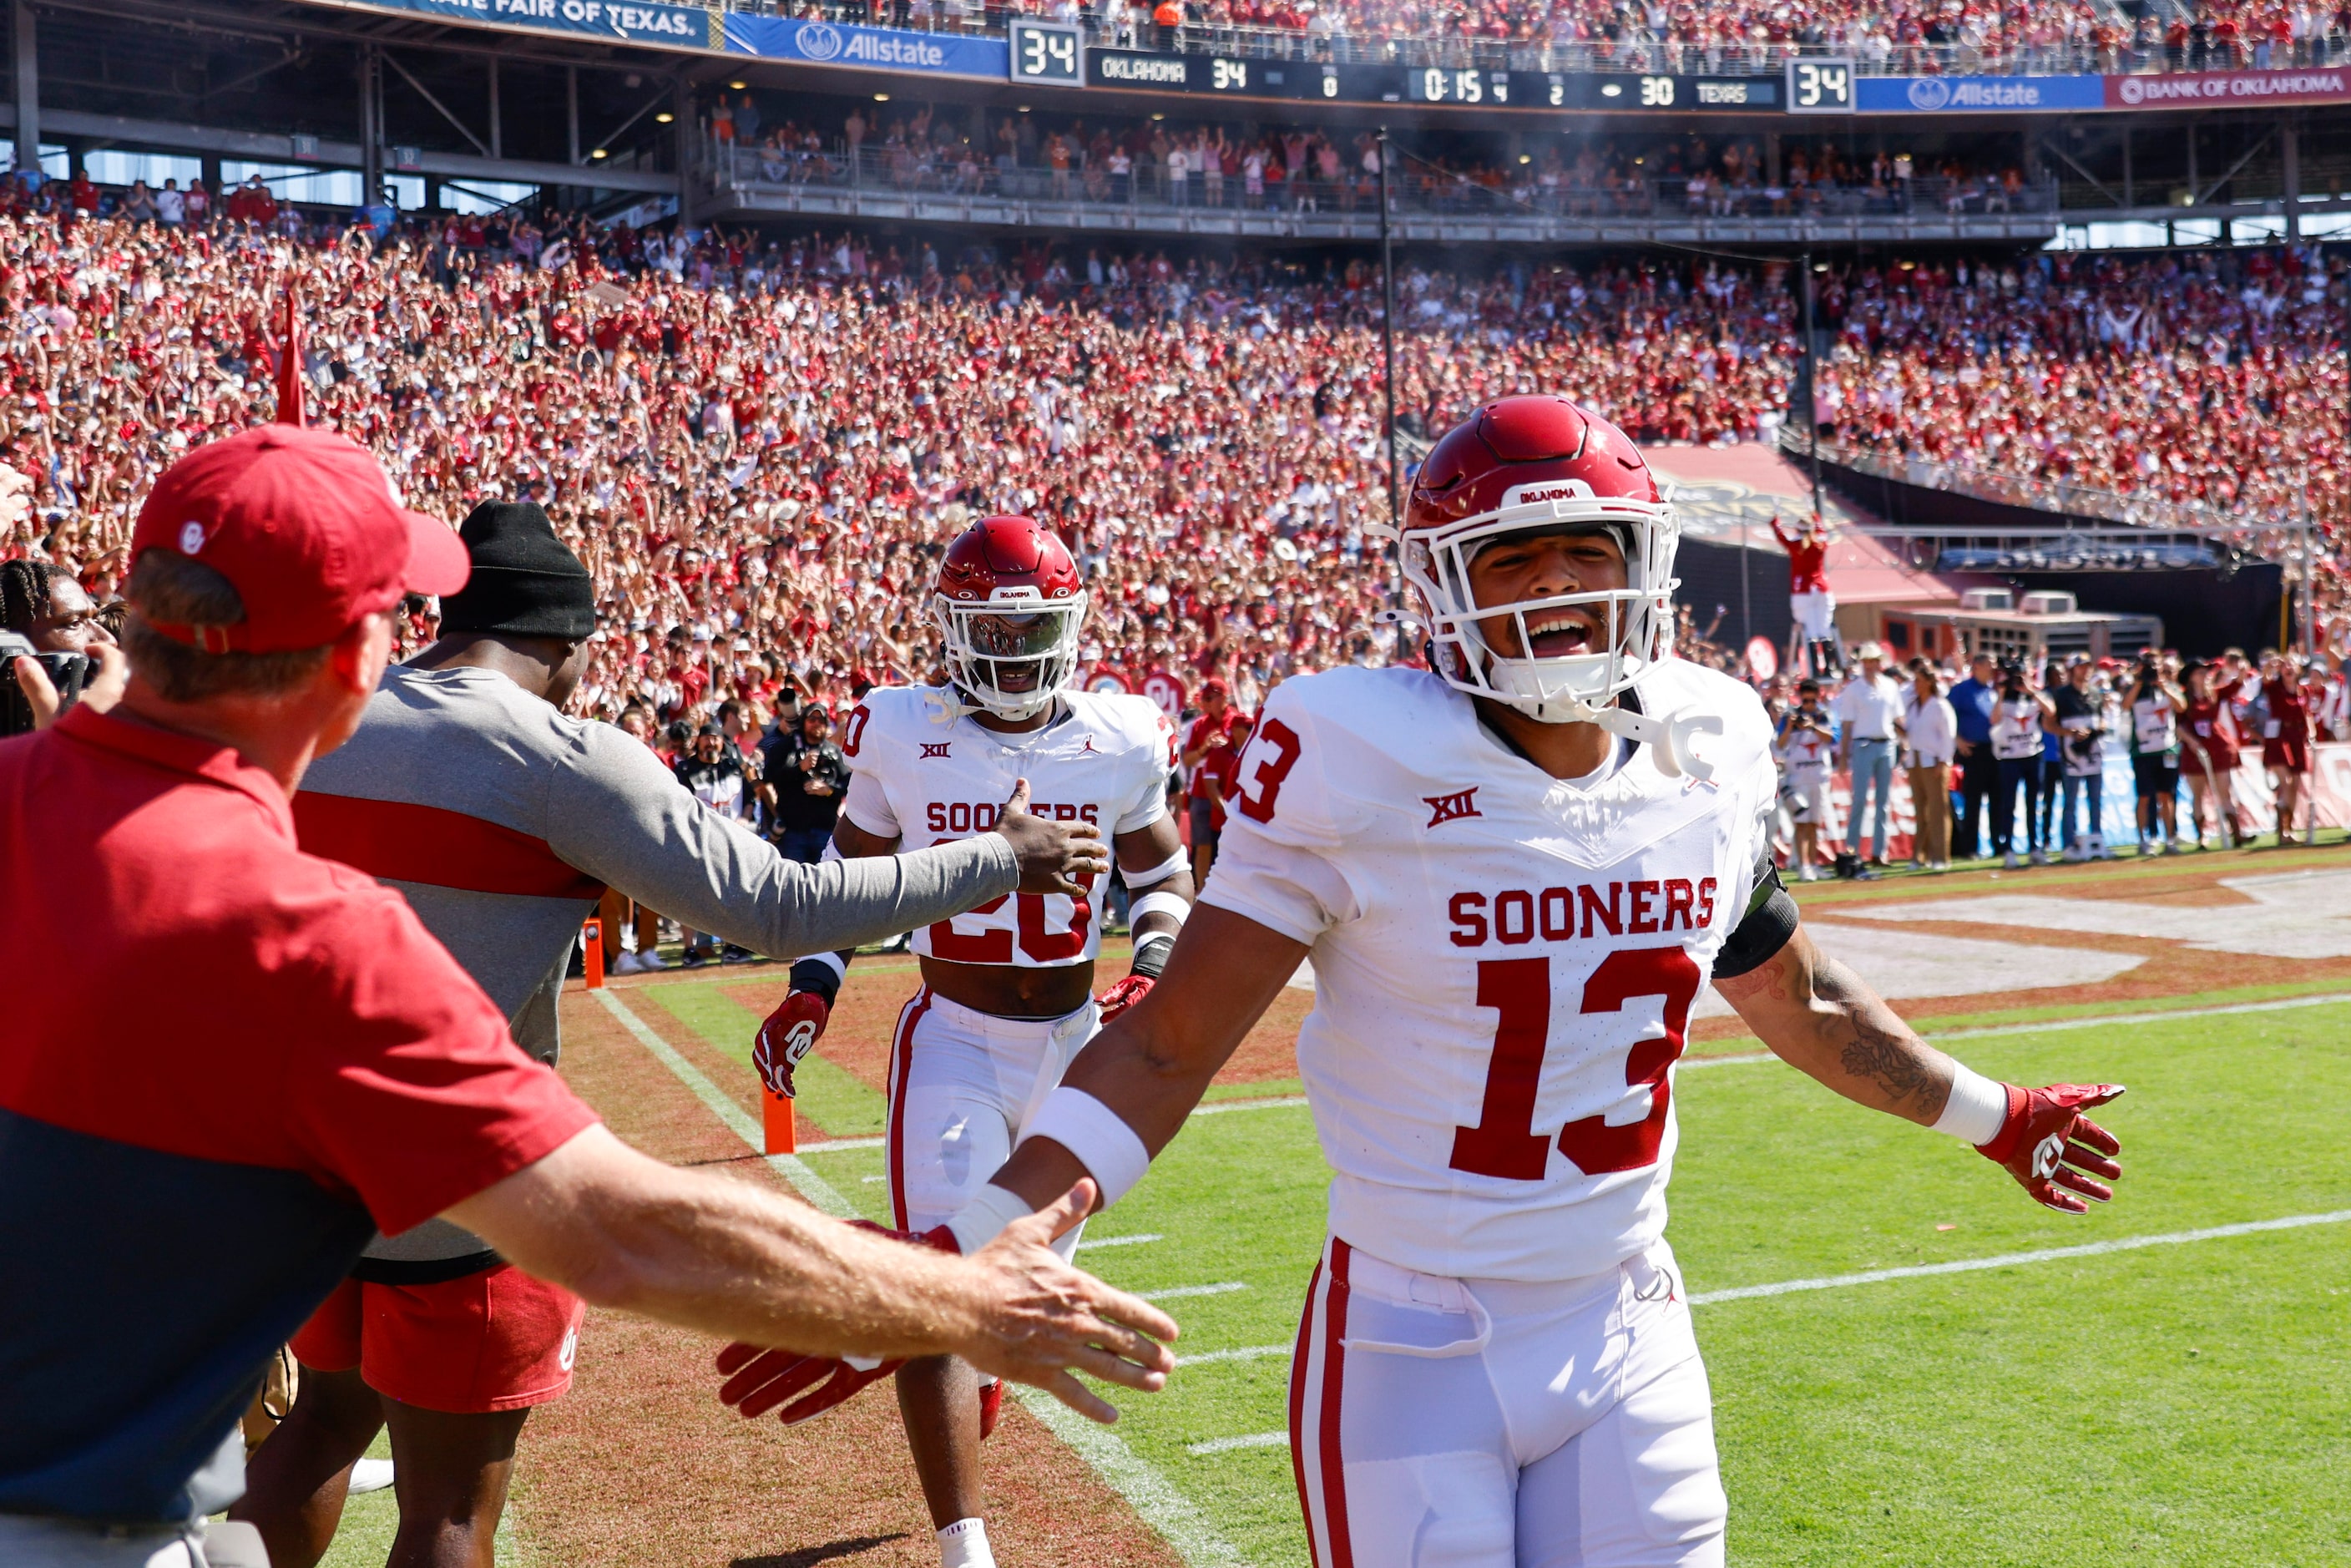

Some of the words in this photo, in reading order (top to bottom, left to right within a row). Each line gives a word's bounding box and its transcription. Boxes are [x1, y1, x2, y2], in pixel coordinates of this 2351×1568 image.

[495, 0, 554, 18] FAIR
[562, 0, 600, 23] OF
[844, 33, 943, 67] Allstate
[1024, 29, 1074, 75] 34
[1101, 56, 1186, 83] OKLAHOMA
[1212, 58, 1247, 89] 34
[1424, 68, 1483, 103] 0:15
[1798, 64, 1848, 107] 34
[2146, 80, 2202, 99] BANK
[2202, 78, 2227, 98] OF
[2230, 74, 2345, 96] OKLAHOMA
[1493, 84, 1508, 102] 4
[1550, 85, 1564, 105] 2
[1641, 77, 1675, 107] 30
[1696, 83, 1748, 104] TEXAS
[1950, 82, 2040, 106] Allstate
[1520, 487, 1577, 504] OKLAHOMA
[999, 590, 1031, 599] OKLAHOMA
[919, 741, 952, 759] XII
[1422, 786, 1483, 829] XII
[1449, 877, 1717, 948] SOONERS
[1449, 946, 1701, 1181] 13
